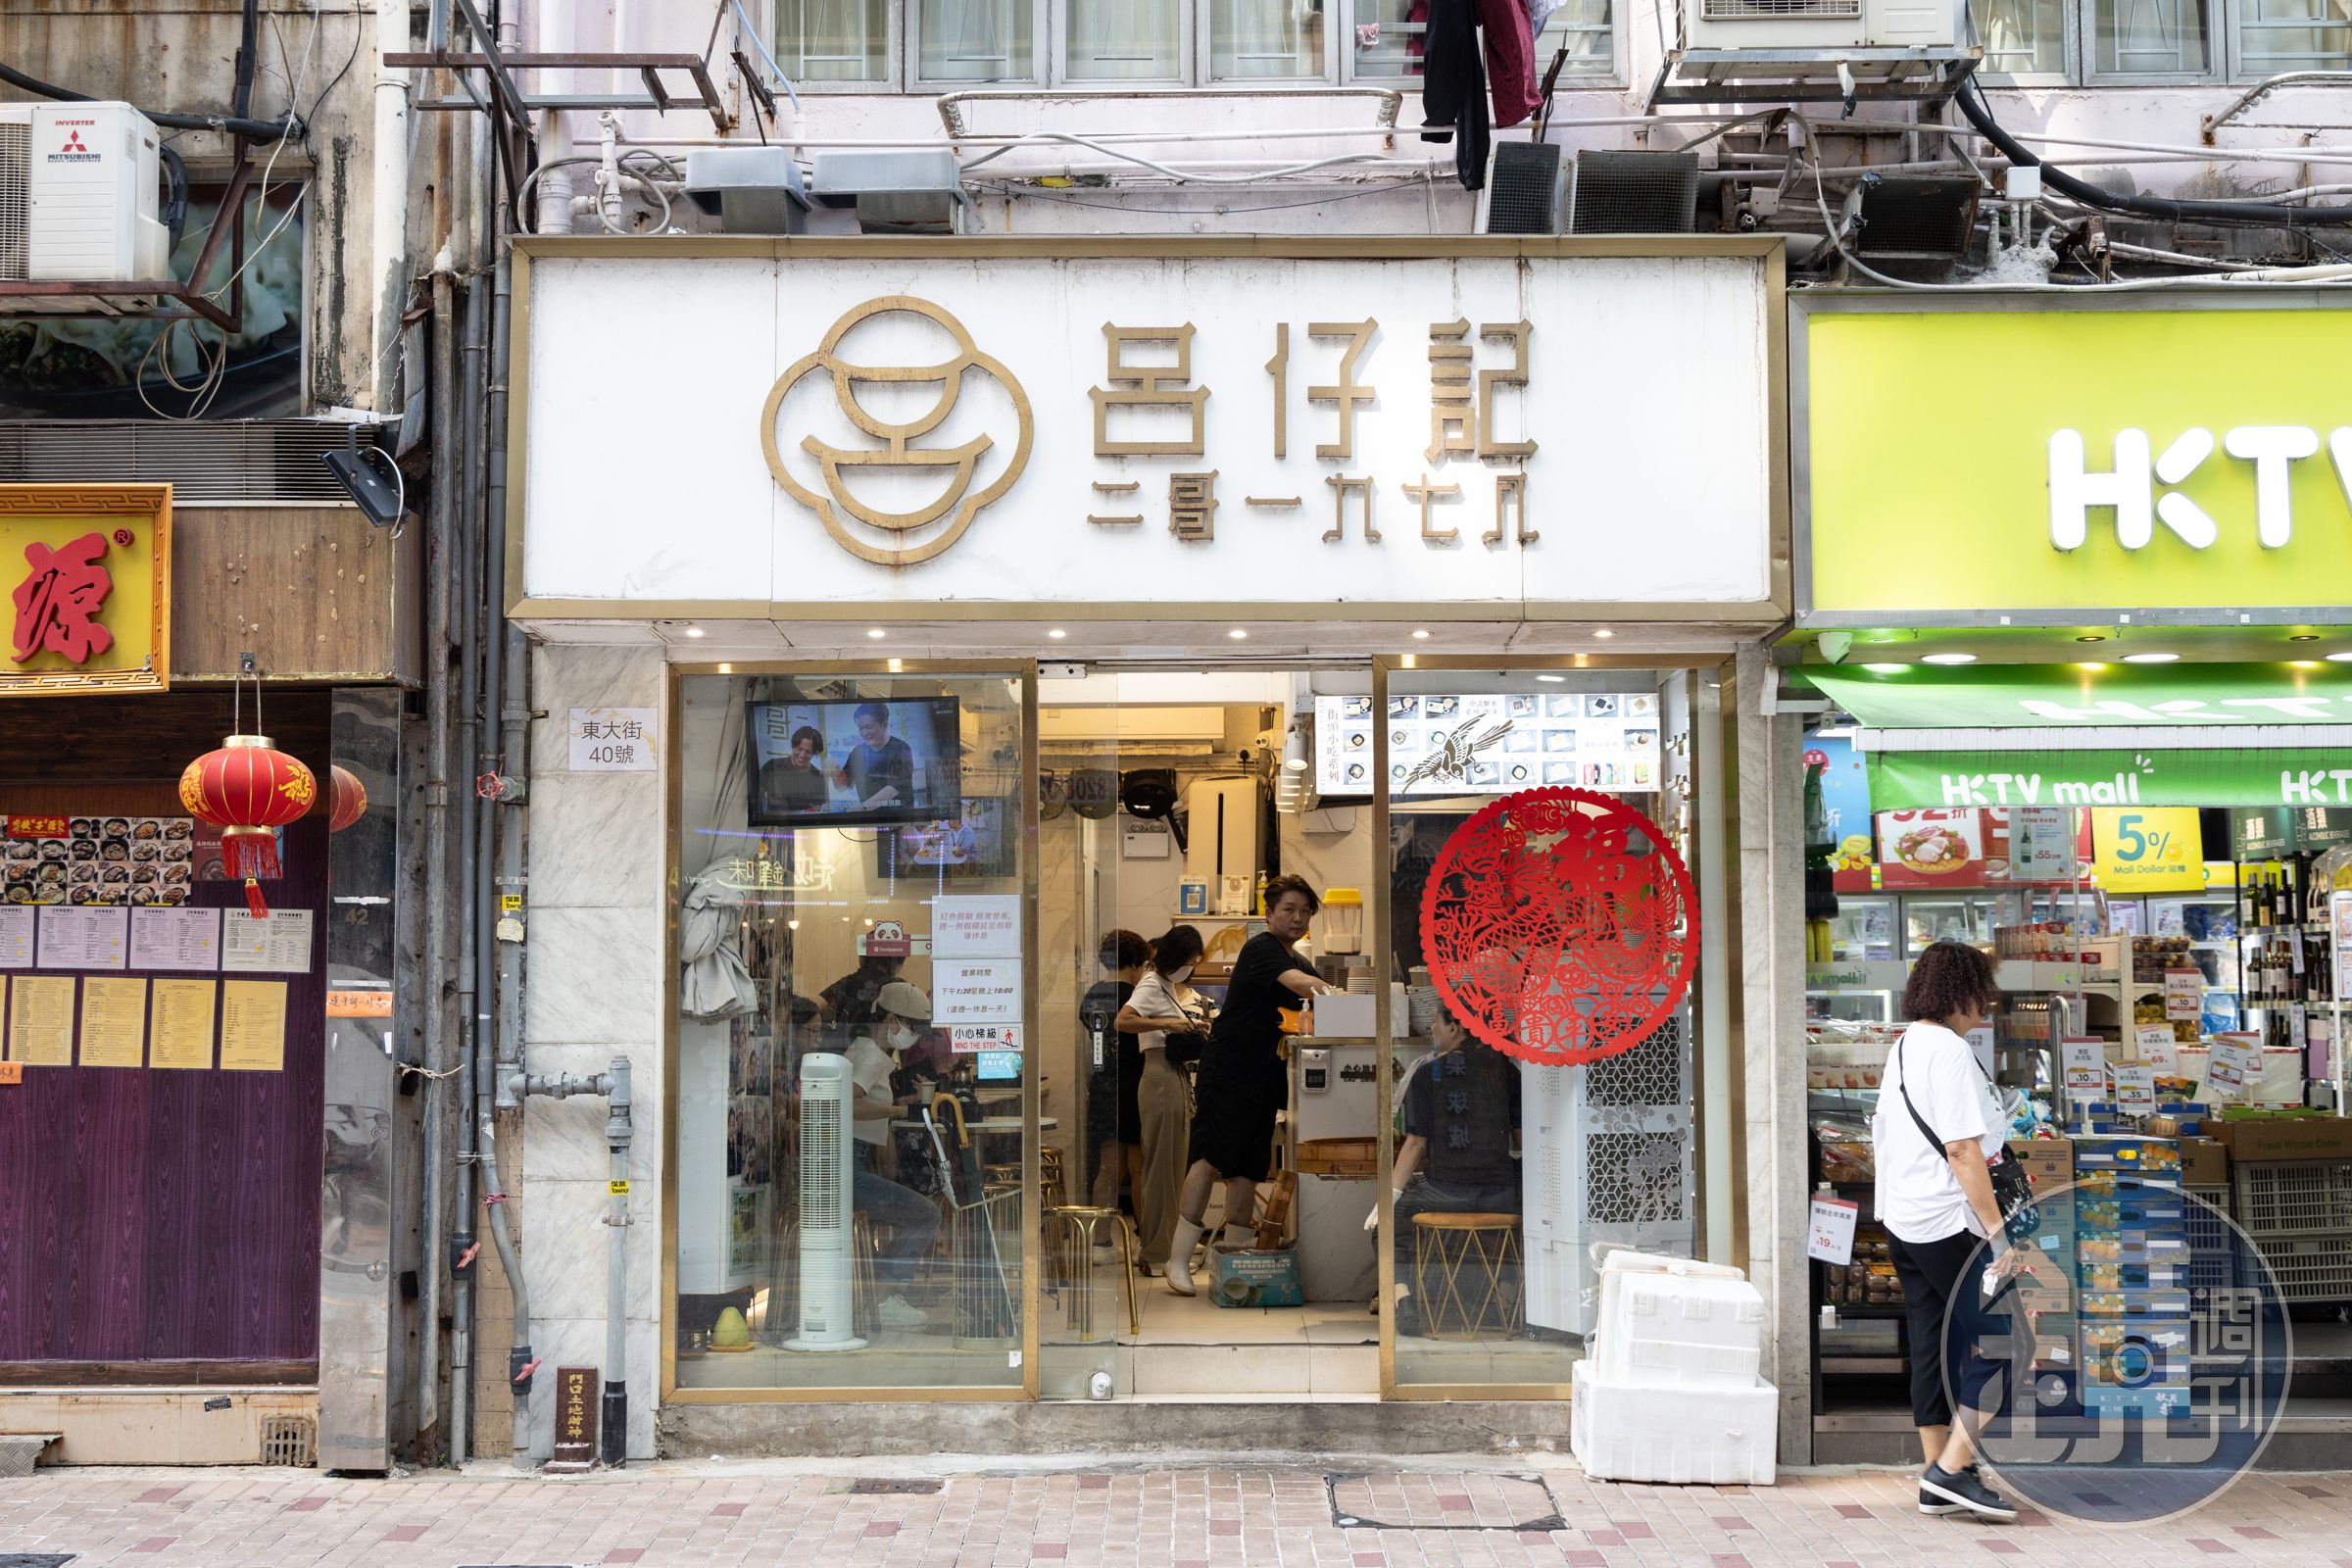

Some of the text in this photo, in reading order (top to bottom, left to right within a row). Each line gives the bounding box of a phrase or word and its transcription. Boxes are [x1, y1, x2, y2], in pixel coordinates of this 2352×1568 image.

[1088, 317, 1540, 463] 呂仔記
[2047, 425, 2352, 552] HKT
[582, 720, 643, 740] 東大街
[589, 745, 635, 764] 40號
[1326, 708, 1340, 783] 街頭小吃系列
[1940, 772, 2140, 806] HKTV mall
[2116, 814, 2171, 861] 5%
[2245, 817, 2265, 840] 酒類
[2114, 865, 2133, 875] Mall
[2137, 865, 2166, 874] Dollar
[344, 907, 369, 926] 42
[940, 912, 973, 921] 紅色假期
[963, 931, 989, 940] 後休息
[961, 968, 992, 977] 營業時間
[955, 1027, 997, 1040] 小心梯級
[567, 1374, 584, 1439] 門口土地財神
